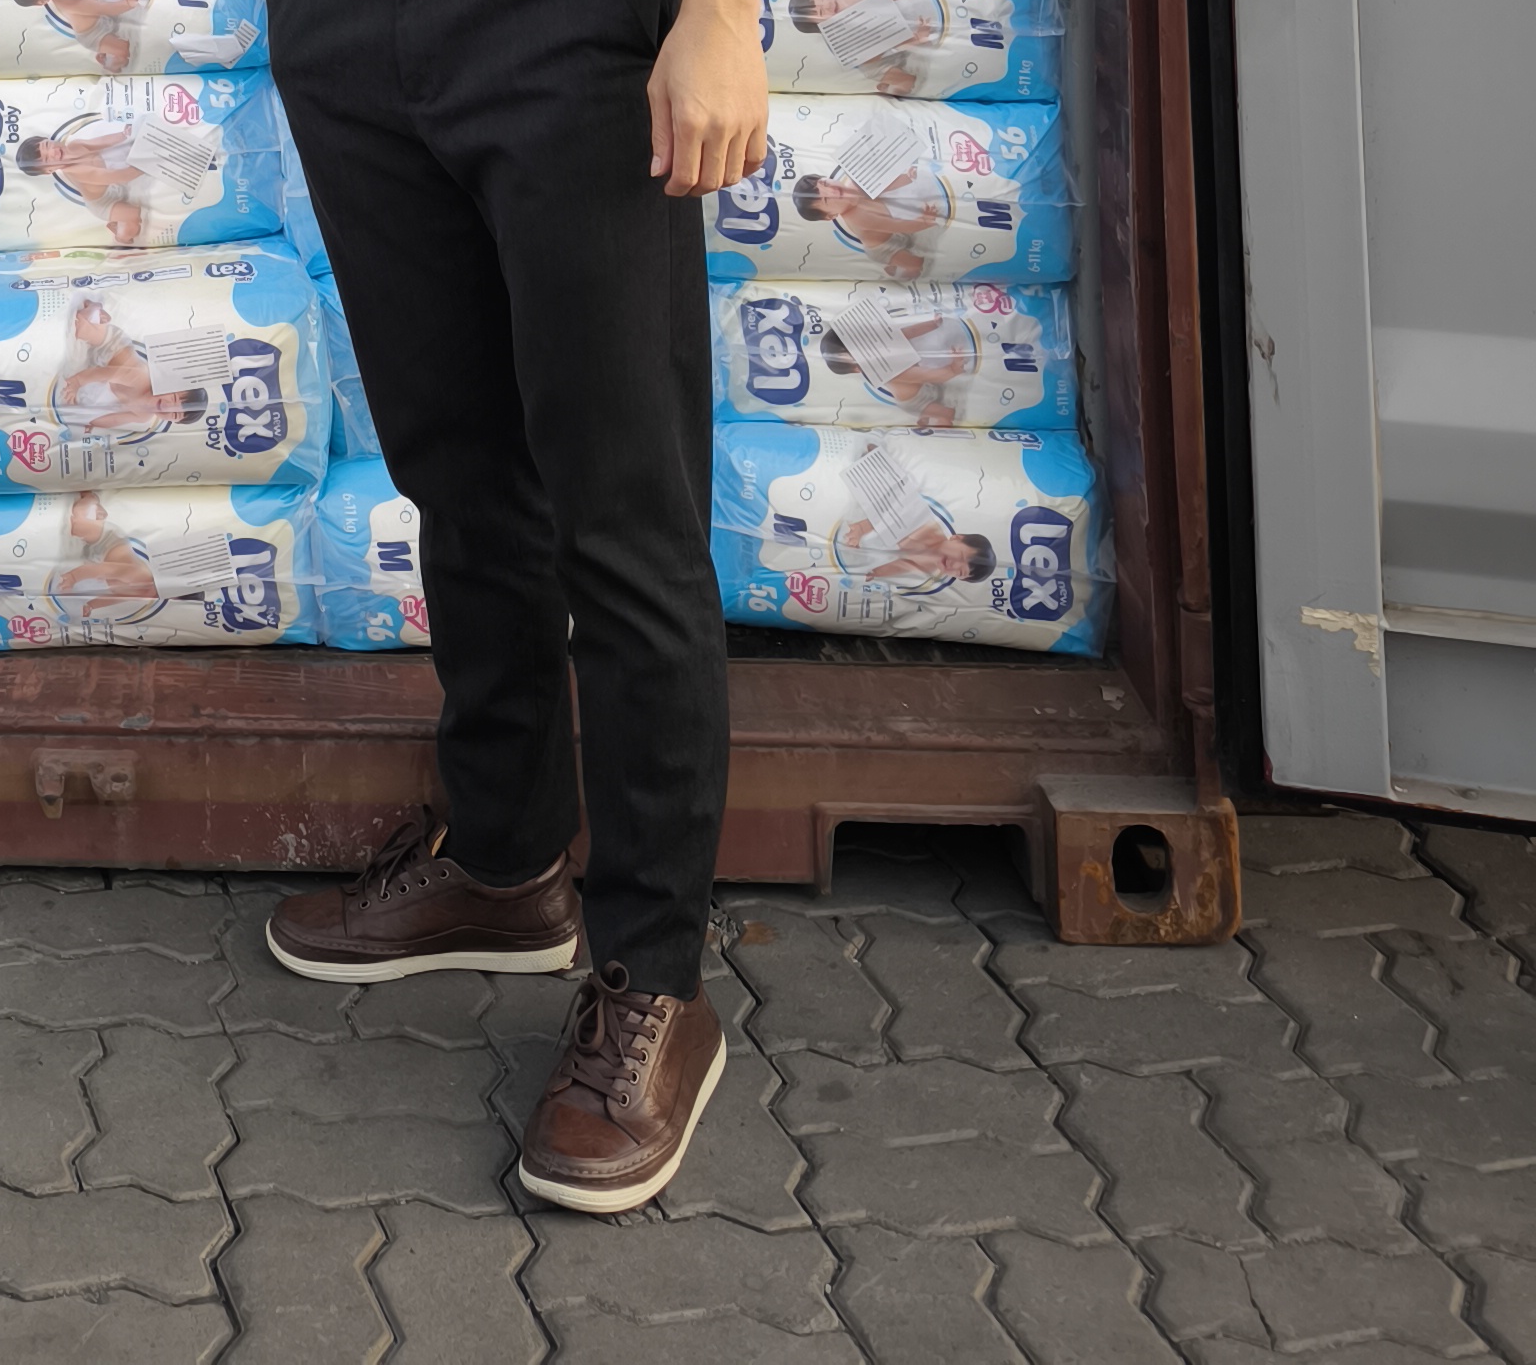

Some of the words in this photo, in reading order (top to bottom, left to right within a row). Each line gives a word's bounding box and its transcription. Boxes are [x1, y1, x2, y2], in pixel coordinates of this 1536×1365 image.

[209, 78, 236, 109] 56
[6, 106, 20, 143] baby
[998, 126, 1028, 162] 56
[782, 143, 796, 180] baby
[977, 201, 1013, 230] M
[272, 413, 282, 437] new
[377, 541, 413, 571] M
[1058, 581, 1068, 607] new
[367, 612, 395, 642] 56
